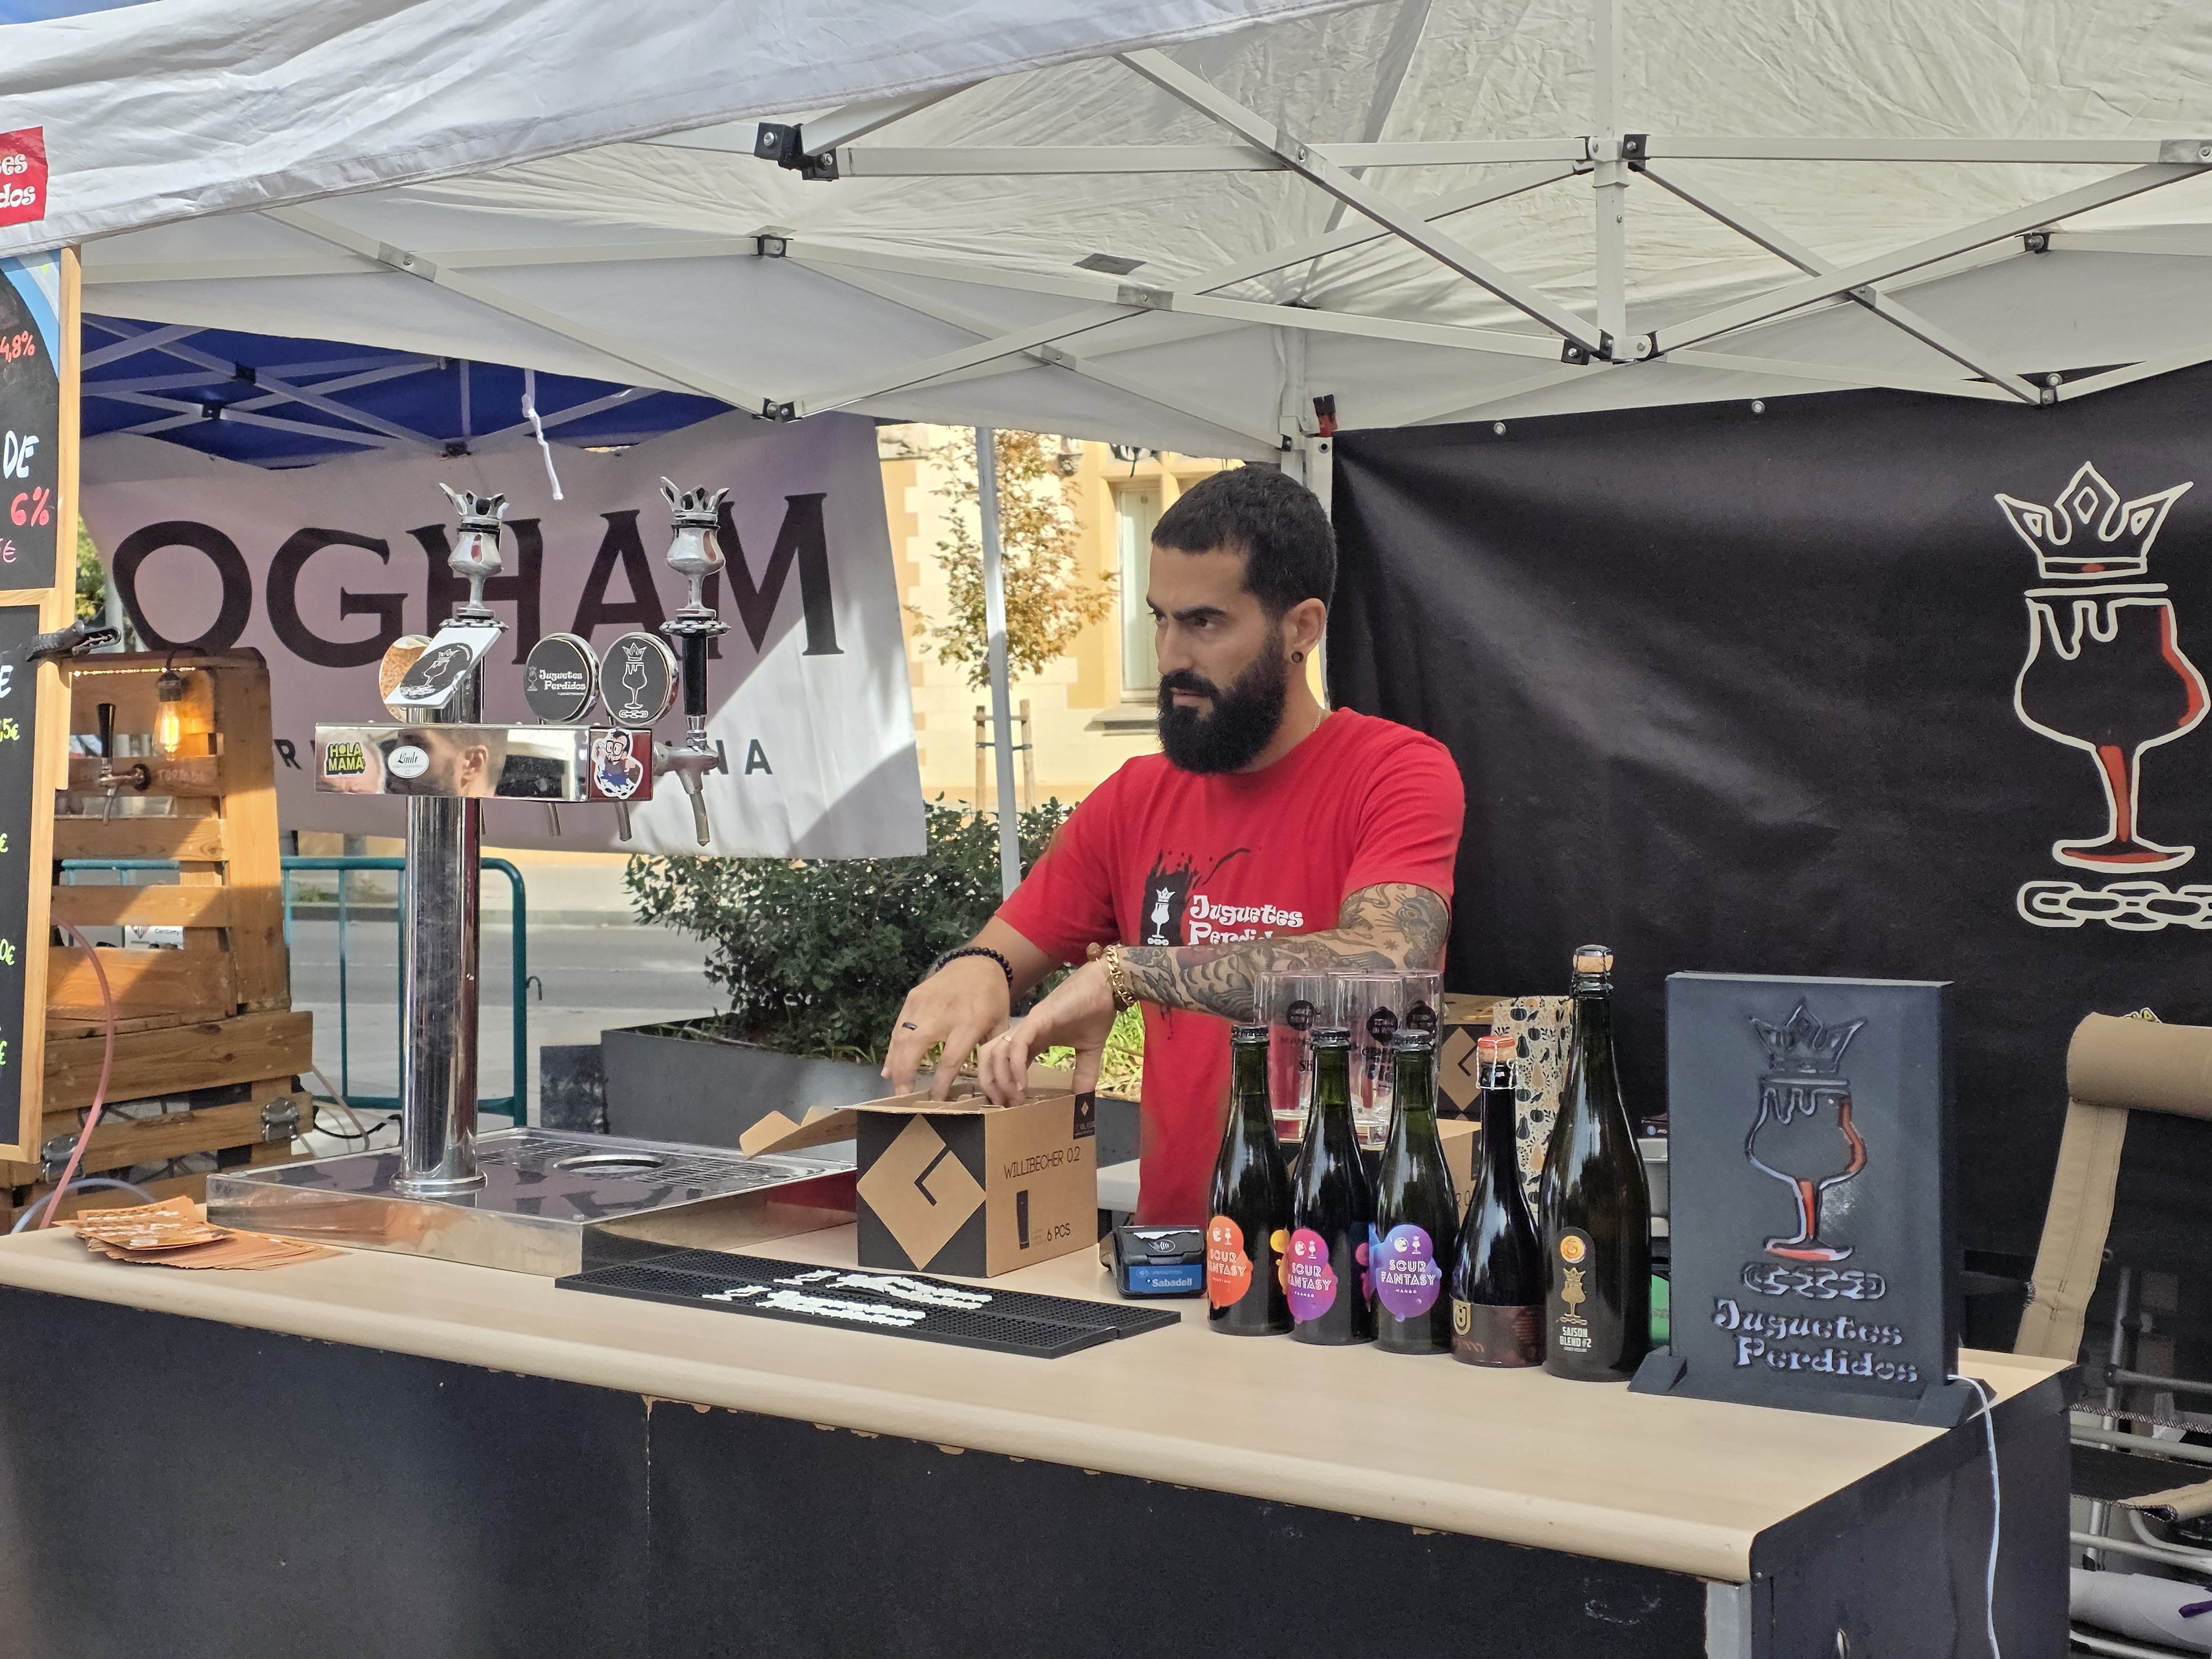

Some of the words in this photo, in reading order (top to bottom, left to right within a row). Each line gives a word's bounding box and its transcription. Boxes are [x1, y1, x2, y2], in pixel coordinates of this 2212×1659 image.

[0, 154, 28, 175] es
[3, 430, 39, 479] DE
[11, 487, 49, 526] 6%
[113, 492, 844, 667] OGHAM
[539, 669, 582, 681] Juguetes
[544, 680, 586, 690] Perdidos
[330, 742, 363, 758] HOLA
[1190, 895, 1304, 927] Juguetes
[1004, 1150, 1064, 1180] WILLIBECHER
[1047, 1228, 1052, 1241] 6
[1054, 1223, 1071, 1240] PCS
[1291, 1262, 1322, 1278] SOUR
[1389, 1259, 1426, 1272] SOUR
[1152, 1278, 1192, 1287] Sabadell
[1381, 1271, 1436, 1286] FANTASY
[1714, 1299, 1903, 1345] Juguetes
[1562, 1326, 1588, 1338] SAISON
[1559, 1335, 1581, 1347] BLEND
[1736, 1335, 1918, 1382] Perdidos
